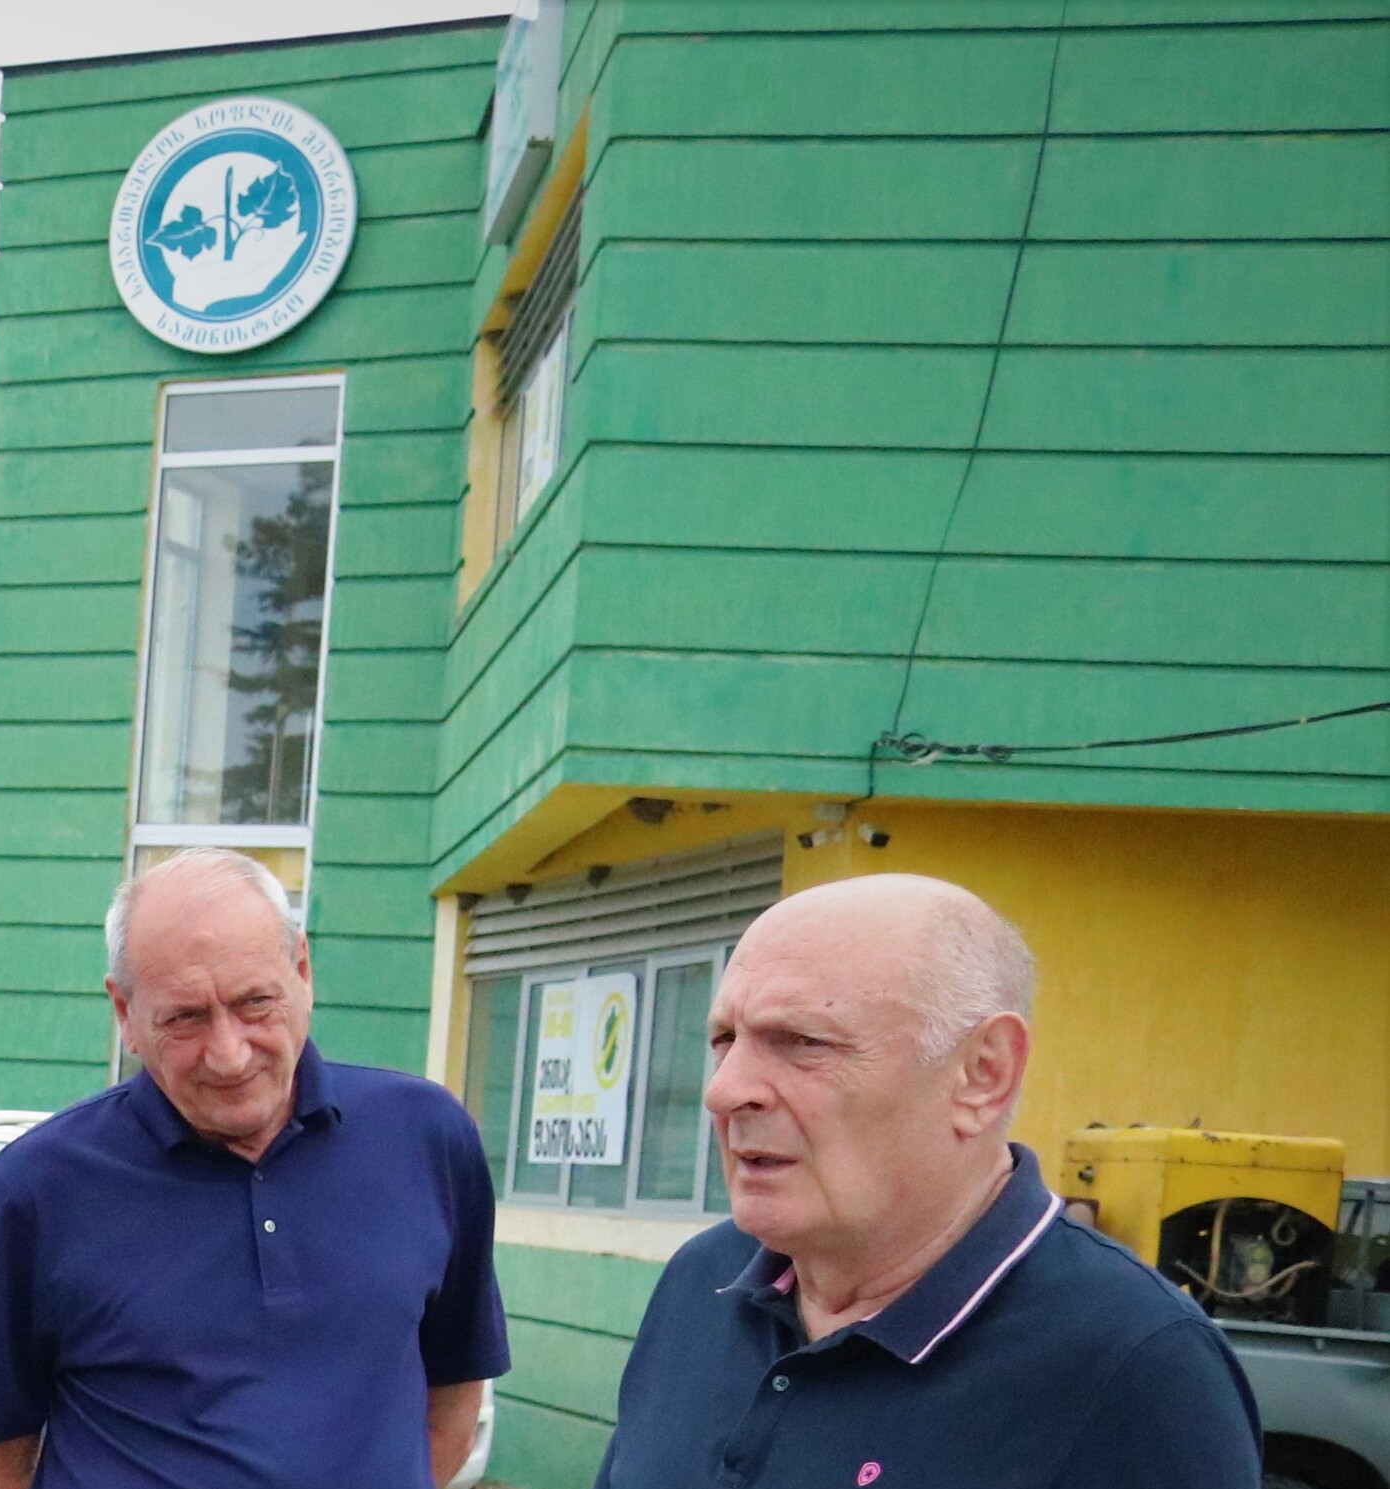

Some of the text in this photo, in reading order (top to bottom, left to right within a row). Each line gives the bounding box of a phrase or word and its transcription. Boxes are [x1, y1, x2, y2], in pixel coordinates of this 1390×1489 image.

[115, 104, 347, 300] საქართველოს სოფლის მეურნეობის
[155, 291, 306, 346] სამინისტრო
